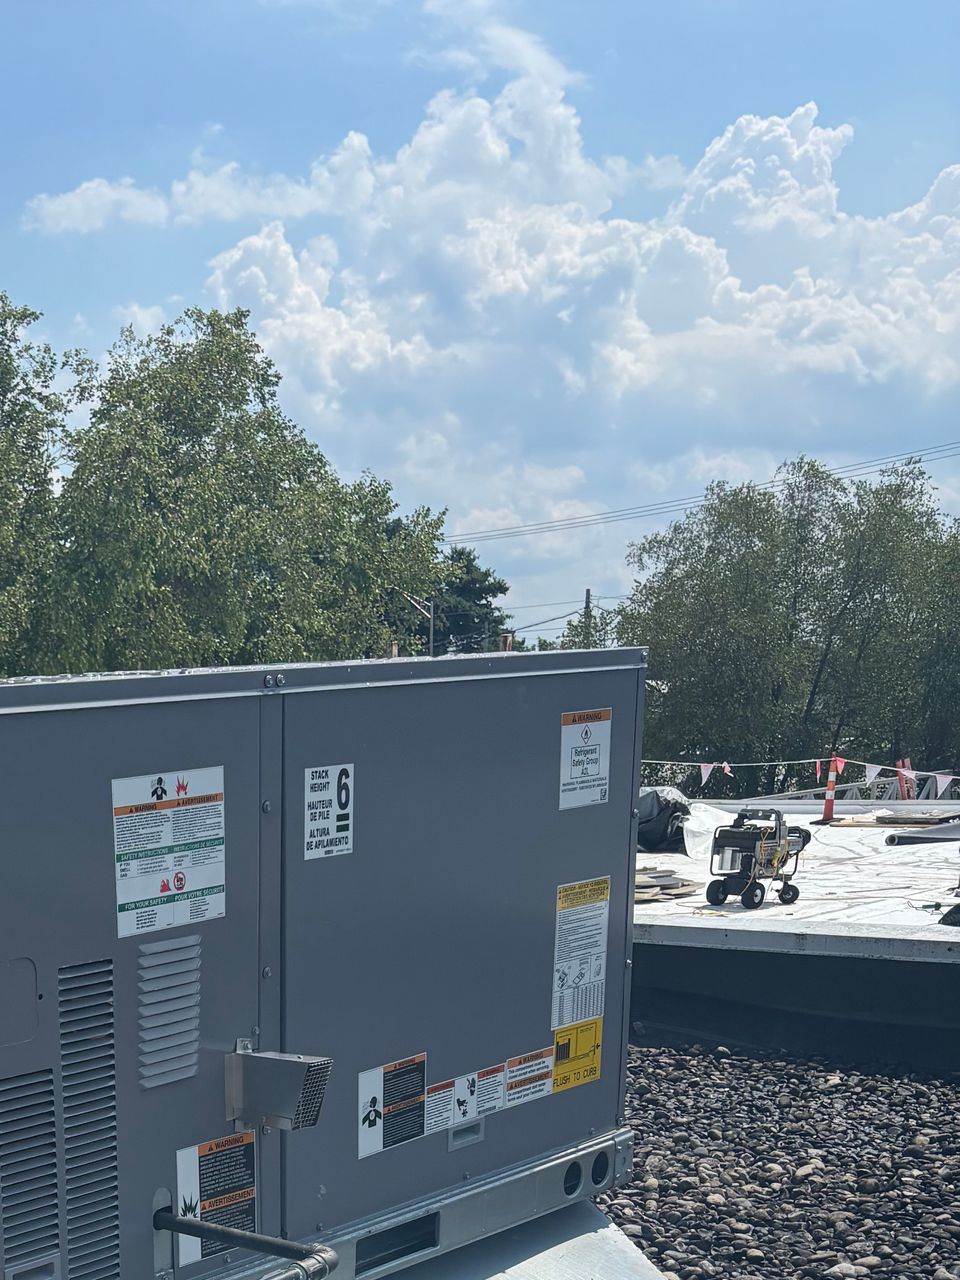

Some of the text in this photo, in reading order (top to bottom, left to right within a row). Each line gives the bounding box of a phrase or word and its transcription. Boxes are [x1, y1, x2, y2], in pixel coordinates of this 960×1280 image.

[311, 769, 329, 781] STACK
[310, 781, 330, 793] HEIGHT
[337, 768, 350, 811] 6
[307, 799, 332, 811] HAUTEUR
[310, 810, 330, 822] DE PILE
[309, 827, 330, 839] ALTURA
[306, 836, 349, 851] DE APILAMIENTO
[553, 1066, 597, 1088] FLUSH TO CURB
[214, 1136, 244, 1150] WARNING
[208, 1188, 255, 1208] AVERTISSEMENT
